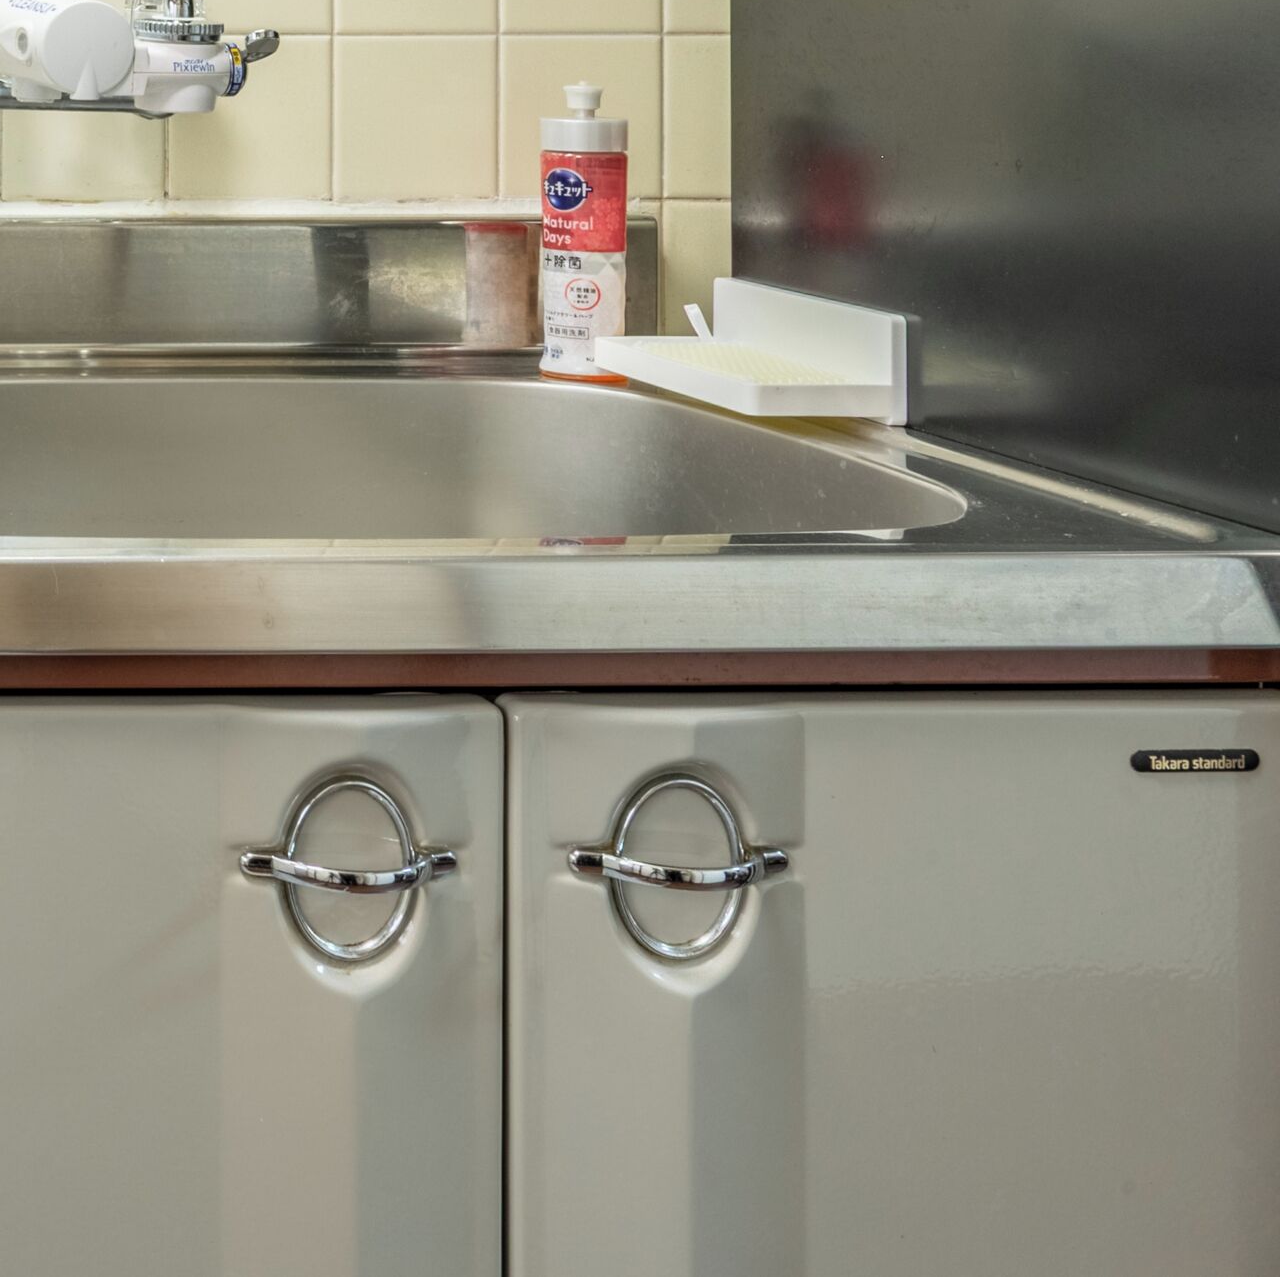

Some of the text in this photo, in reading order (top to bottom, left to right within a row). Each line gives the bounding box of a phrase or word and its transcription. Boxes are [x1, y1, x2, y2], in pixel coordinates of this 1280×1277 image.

[173, 62, 215, 72] Pixiewin
[543, 180, 592, 198] キュキュット
[543, 214, 593, 230] Natural
[543, 229, 572, 246] Days
[1149, 755, 1246, 770] Takara standard
